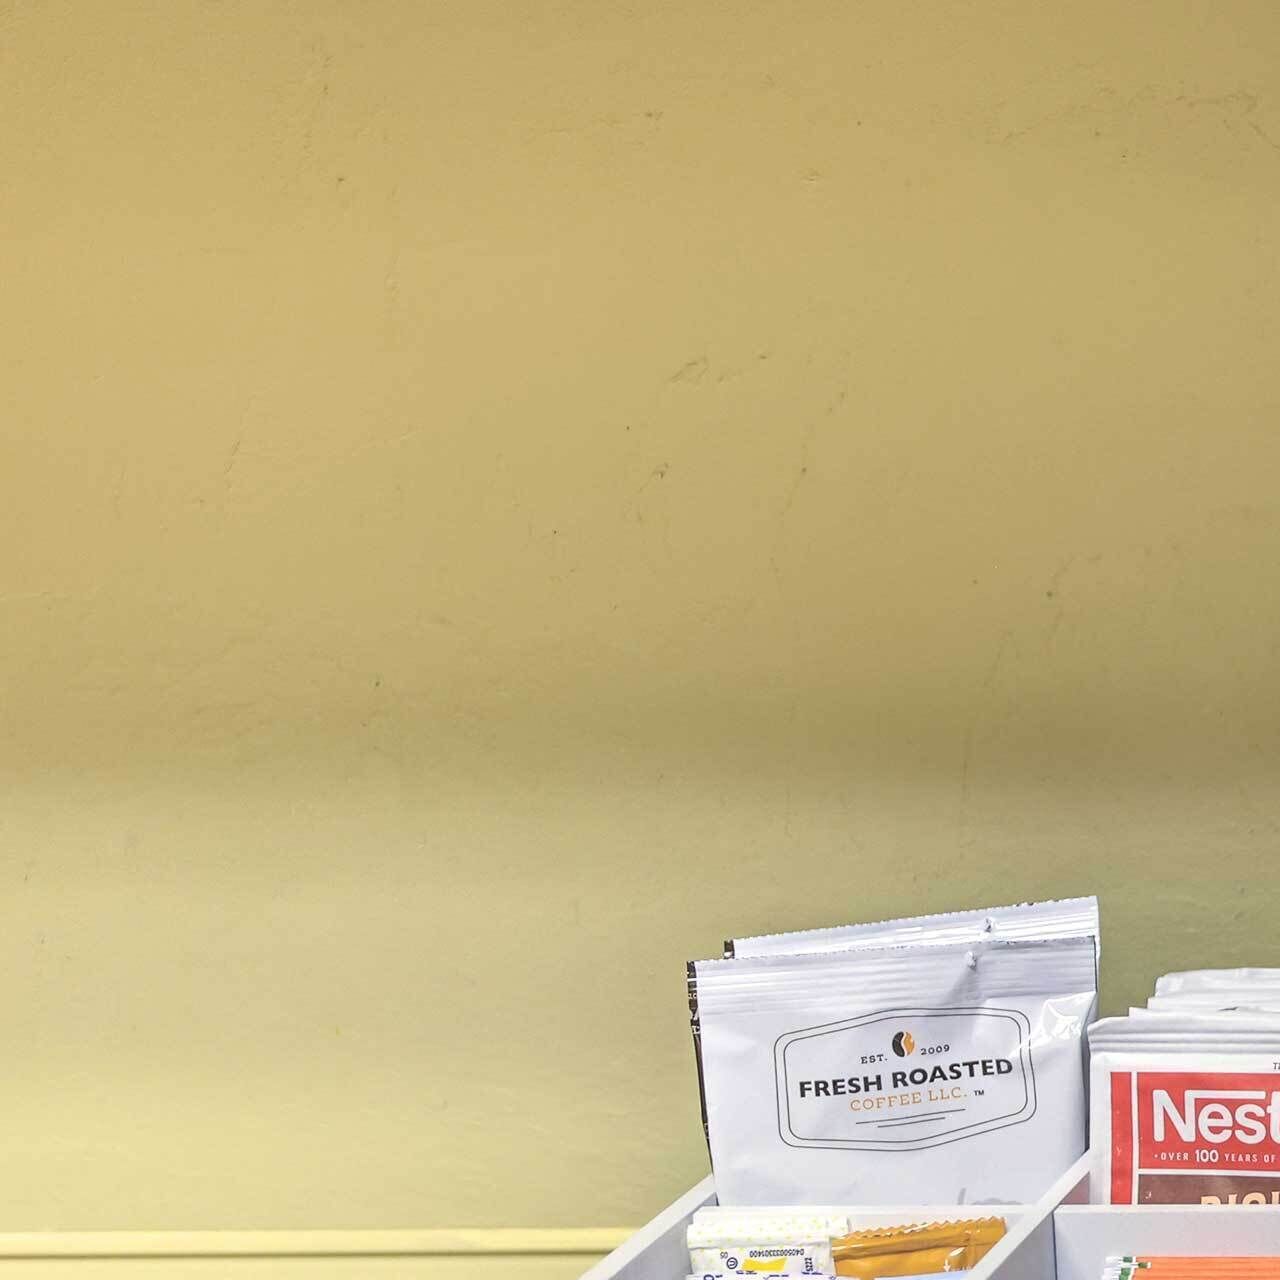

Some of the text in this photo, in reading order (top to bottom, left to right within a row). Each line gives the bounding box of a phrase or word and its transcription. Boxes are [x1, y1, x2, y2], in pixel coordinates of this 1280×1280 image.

[861, 1044, 950, 1065] EST. 2009
[799, 1059, 1013, 1098] FRESH ROASTED
[850, 1092, 922, 1111] COFFEE
[928, 1086, 967, 1101] LLC.
[1160, 1153, 1189, 1161] OVER
[1195, 1150, 1219, 1162] 100
[1224, 1153, 1258, 1162] YEARS
[1264, 1154, 1275, 1163] OF
